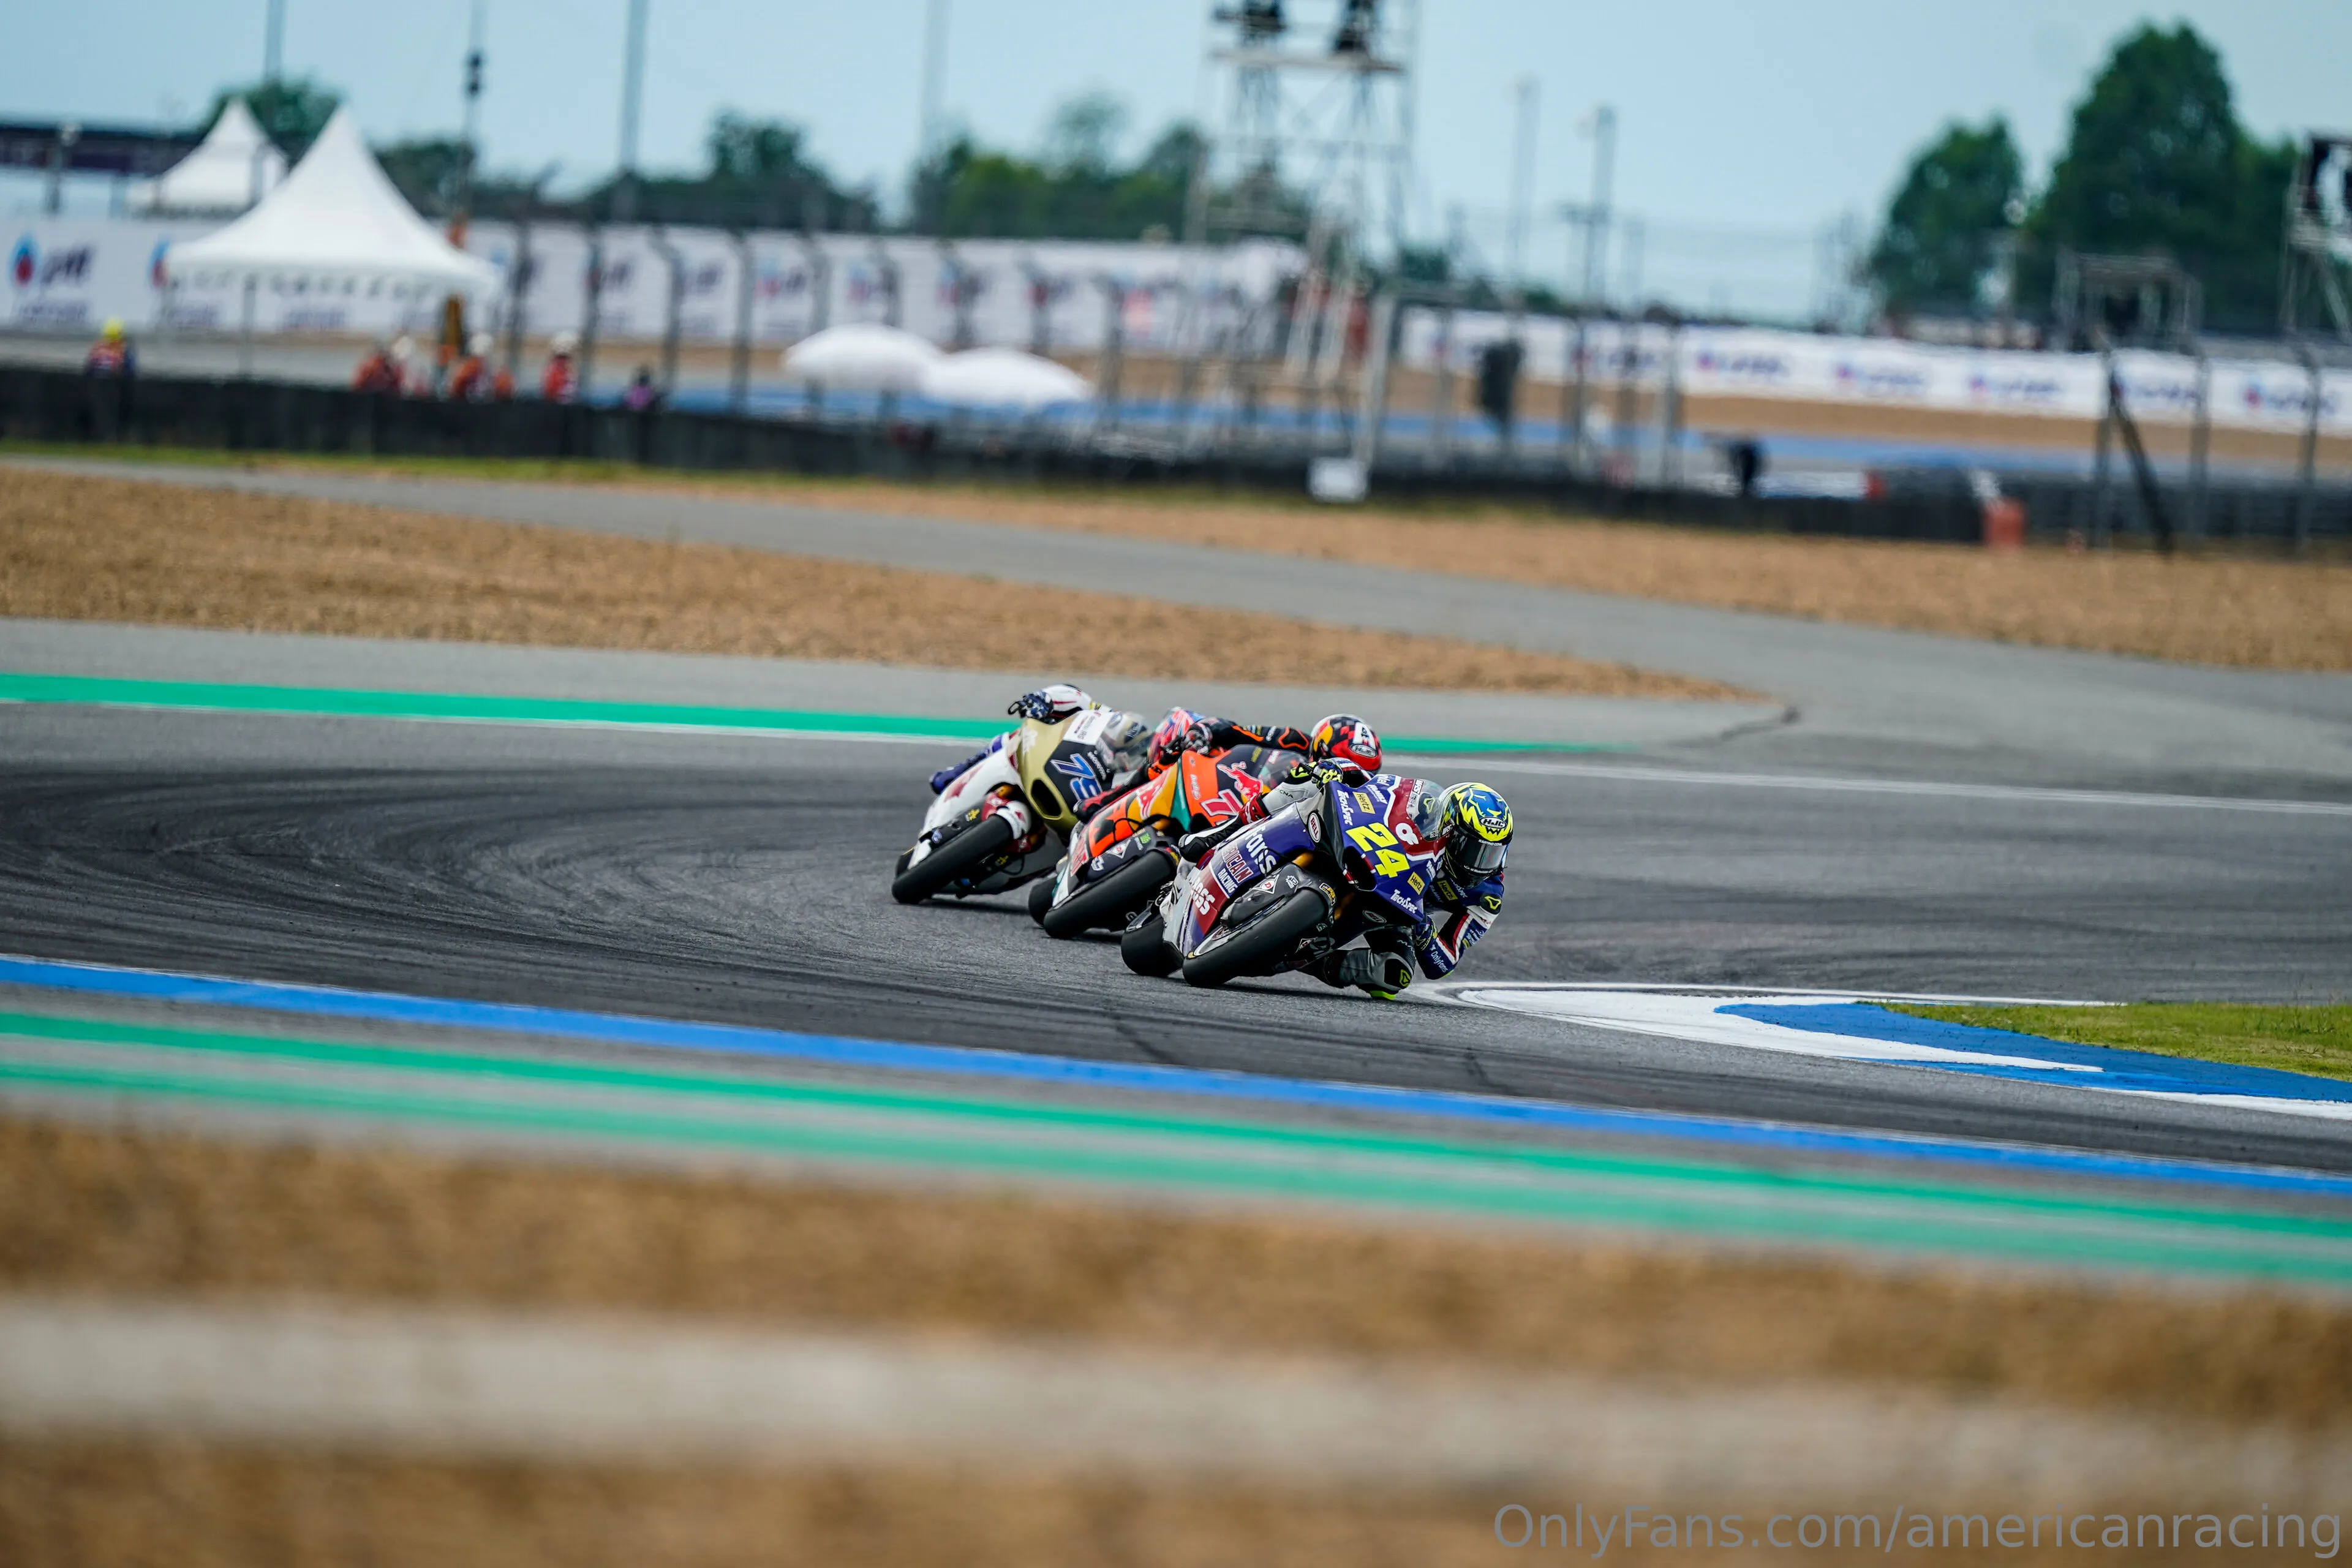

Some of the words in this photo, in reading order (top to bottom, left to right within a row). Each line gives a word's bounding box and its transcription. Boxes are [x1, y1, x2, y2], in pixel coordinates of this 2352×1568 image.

[1357, 793, 1370, 811] Hertz
[1310, 816, 1319, 839] BELL
[1483, 819, 1504, 827] HJC
[1346, 823, 1410, 878] 24
[1217, 868, 1238, 894] RACING
[1410, 874, 1422, 891] Hertz
[1430, 951, 1449, 973] OnlyFans
